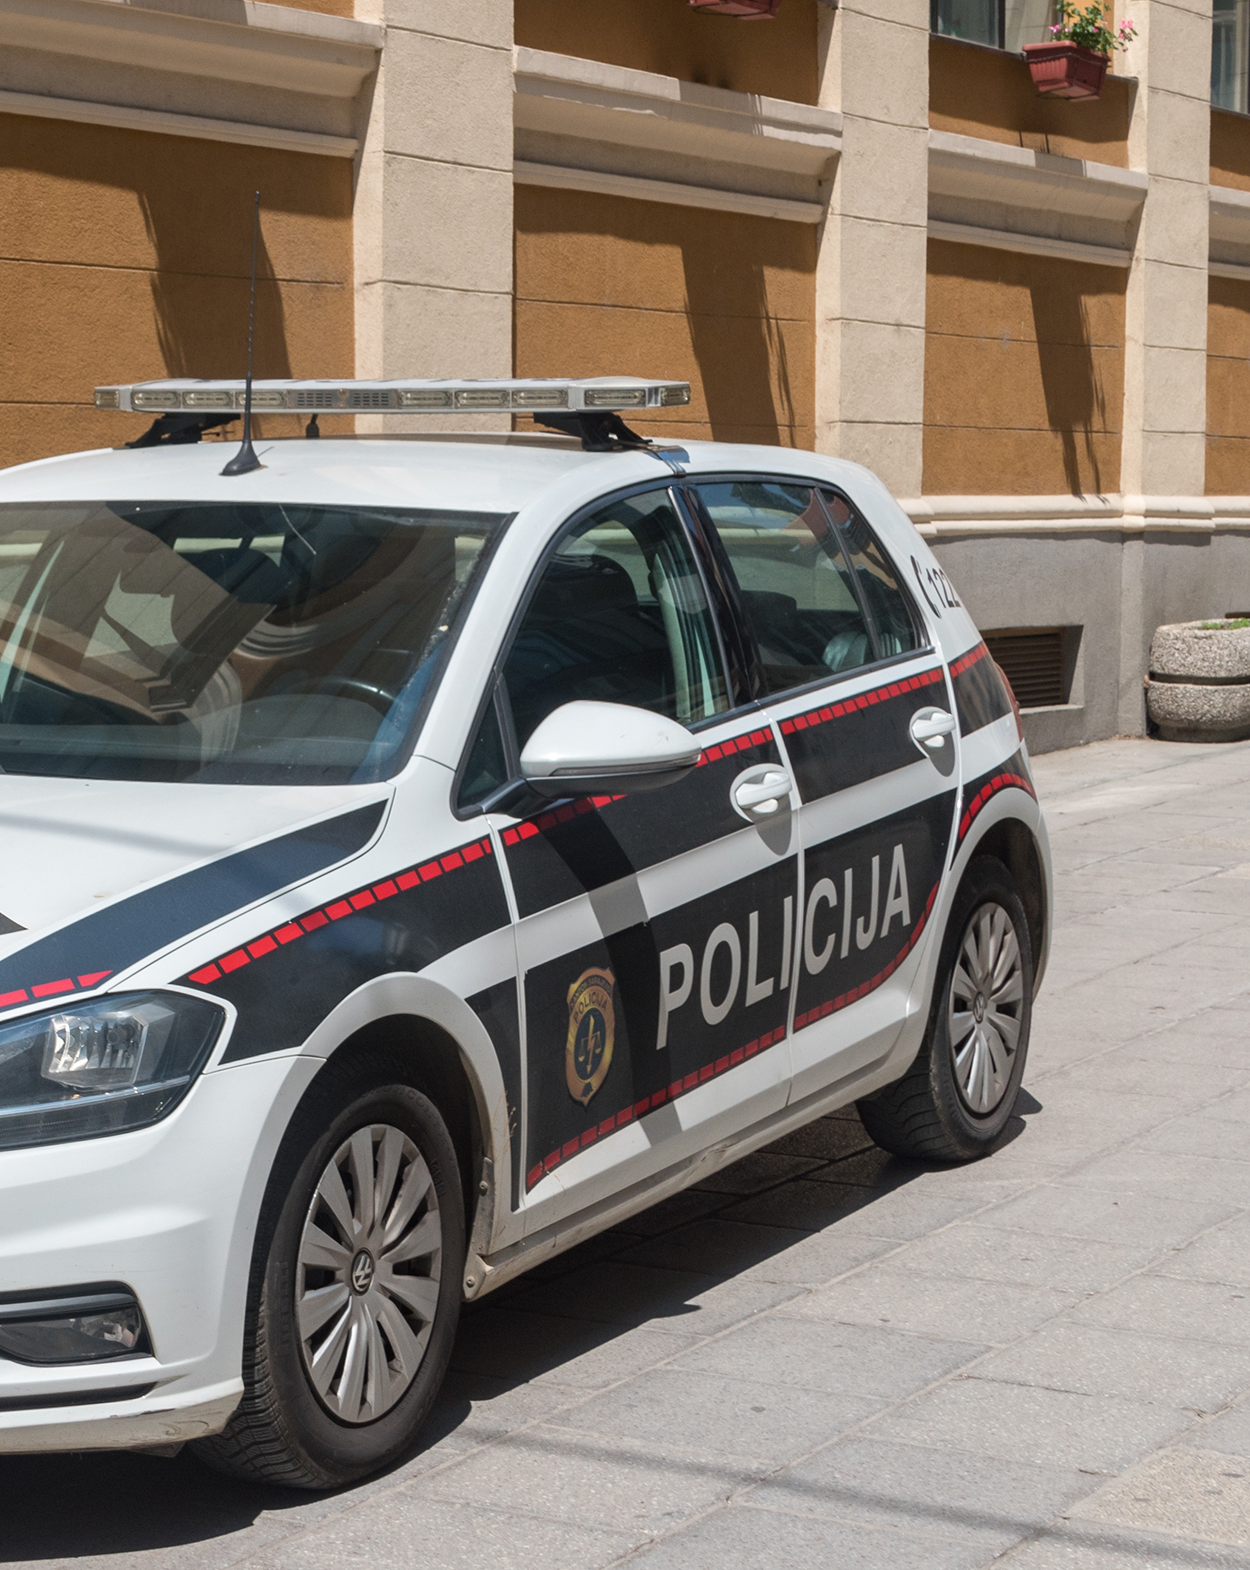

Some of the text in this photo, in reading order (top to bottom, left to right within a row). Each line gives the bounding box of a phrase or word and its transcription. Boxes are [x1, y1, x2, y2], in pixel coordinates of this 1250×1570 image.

[925, 567, 961, 609] 122
[656, 843, 911, 1050] POLICIJA
[573, 991, 608, 1024] POLICIJA
